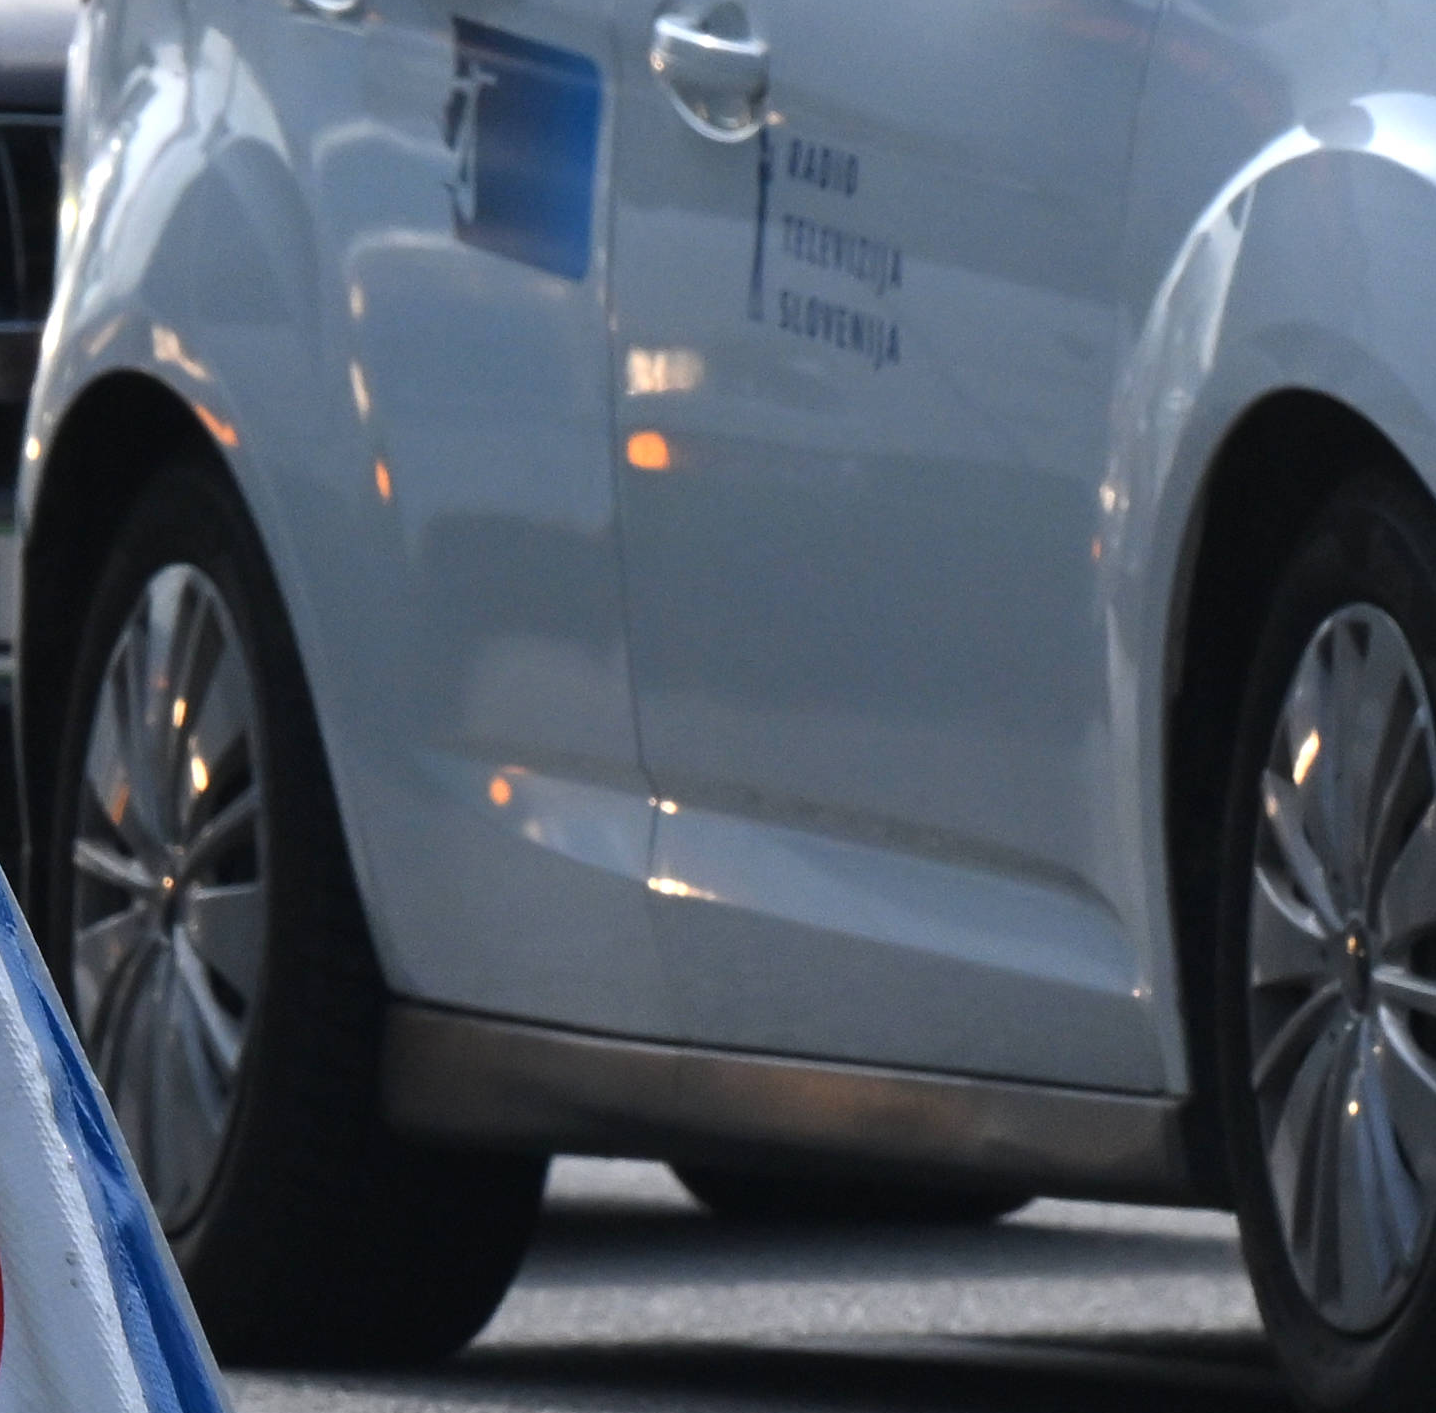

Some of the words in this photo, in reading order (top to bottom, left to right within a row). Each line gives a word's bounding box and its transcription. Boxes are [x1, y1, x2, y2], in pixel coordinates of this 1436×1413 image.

[787, 138, 859, 198] RADIO
[781, 212, 903, 296] TELEVIZIJA
[778, 289, 901, 371] SLOVENIJA
